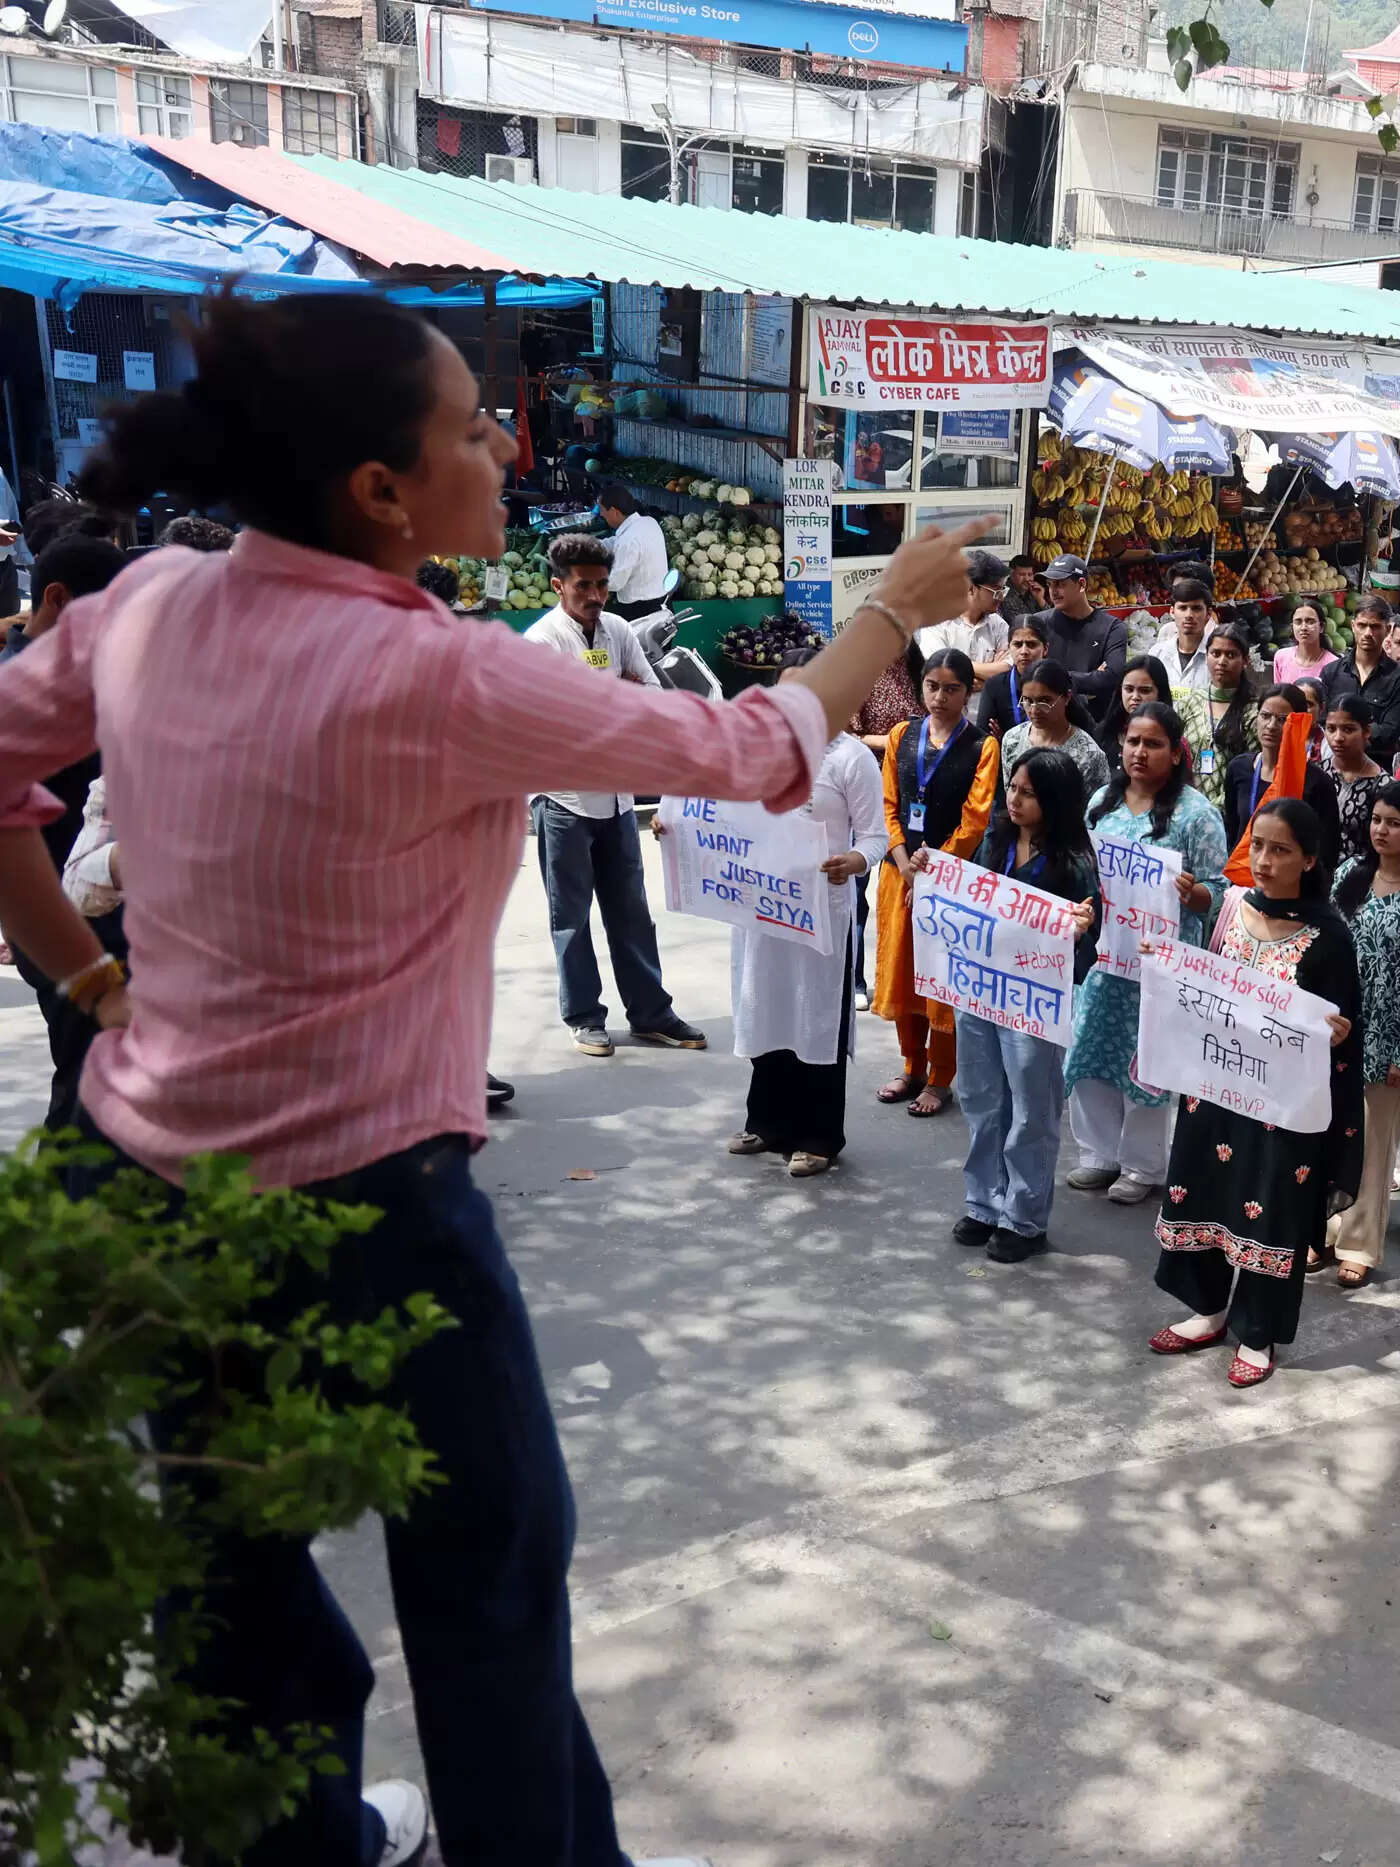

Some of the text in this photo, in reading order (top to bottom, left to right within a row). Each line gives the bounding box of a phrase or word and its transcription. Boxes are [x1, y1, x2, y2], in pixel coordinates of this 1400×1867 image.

[700, 5, 740, 21] Store
[851, 32, 876, 42] DELL
[825, 318, 862, 339] AJAY
[869, 324, 1046, 379] लोक मित्र केन्द्र
[1172, 341, 1230, 357] स्थापना
[1302, 353, 1329, 368] 500
[879, 386, 921, 400] CYBER
[926, 386, 960, 400] CAFE
[795, 460, 818, 473] LOK
[788, 477, 824, 490] MITAR
[784, 494, 830, 507] KENDRA
[785, 509, 830, 528] लोकमित्र
[796, 530, 818, 549] केन्द्र
[805, 556, 828, 565] CSC
[805, 591, 812, 600] of
[808, 583, 821, 591] type
[785, 601, 832, 609] Online Services
[682, 796, 717, 823] WE
[696, 829, 755, 858] WANT
[1097, 839, 1164, 888] सुरक्षित
[720, 860, 803, 900] JUSTICE
[702, 878, 814, 931] FOR SIYA
[967, 871, 1000, 909] की
[998, 887, 1053, 934] आग
[916, 893, 999, 958] उड़ता
[1015, 946, 1065, 979] #abvp
[947, 946, 1065, 1025] हिमाचल
[1176, 977, 1311, 1054] इंसाफ कब
[1200, 1033, 1270, 1085] मिलेगा
